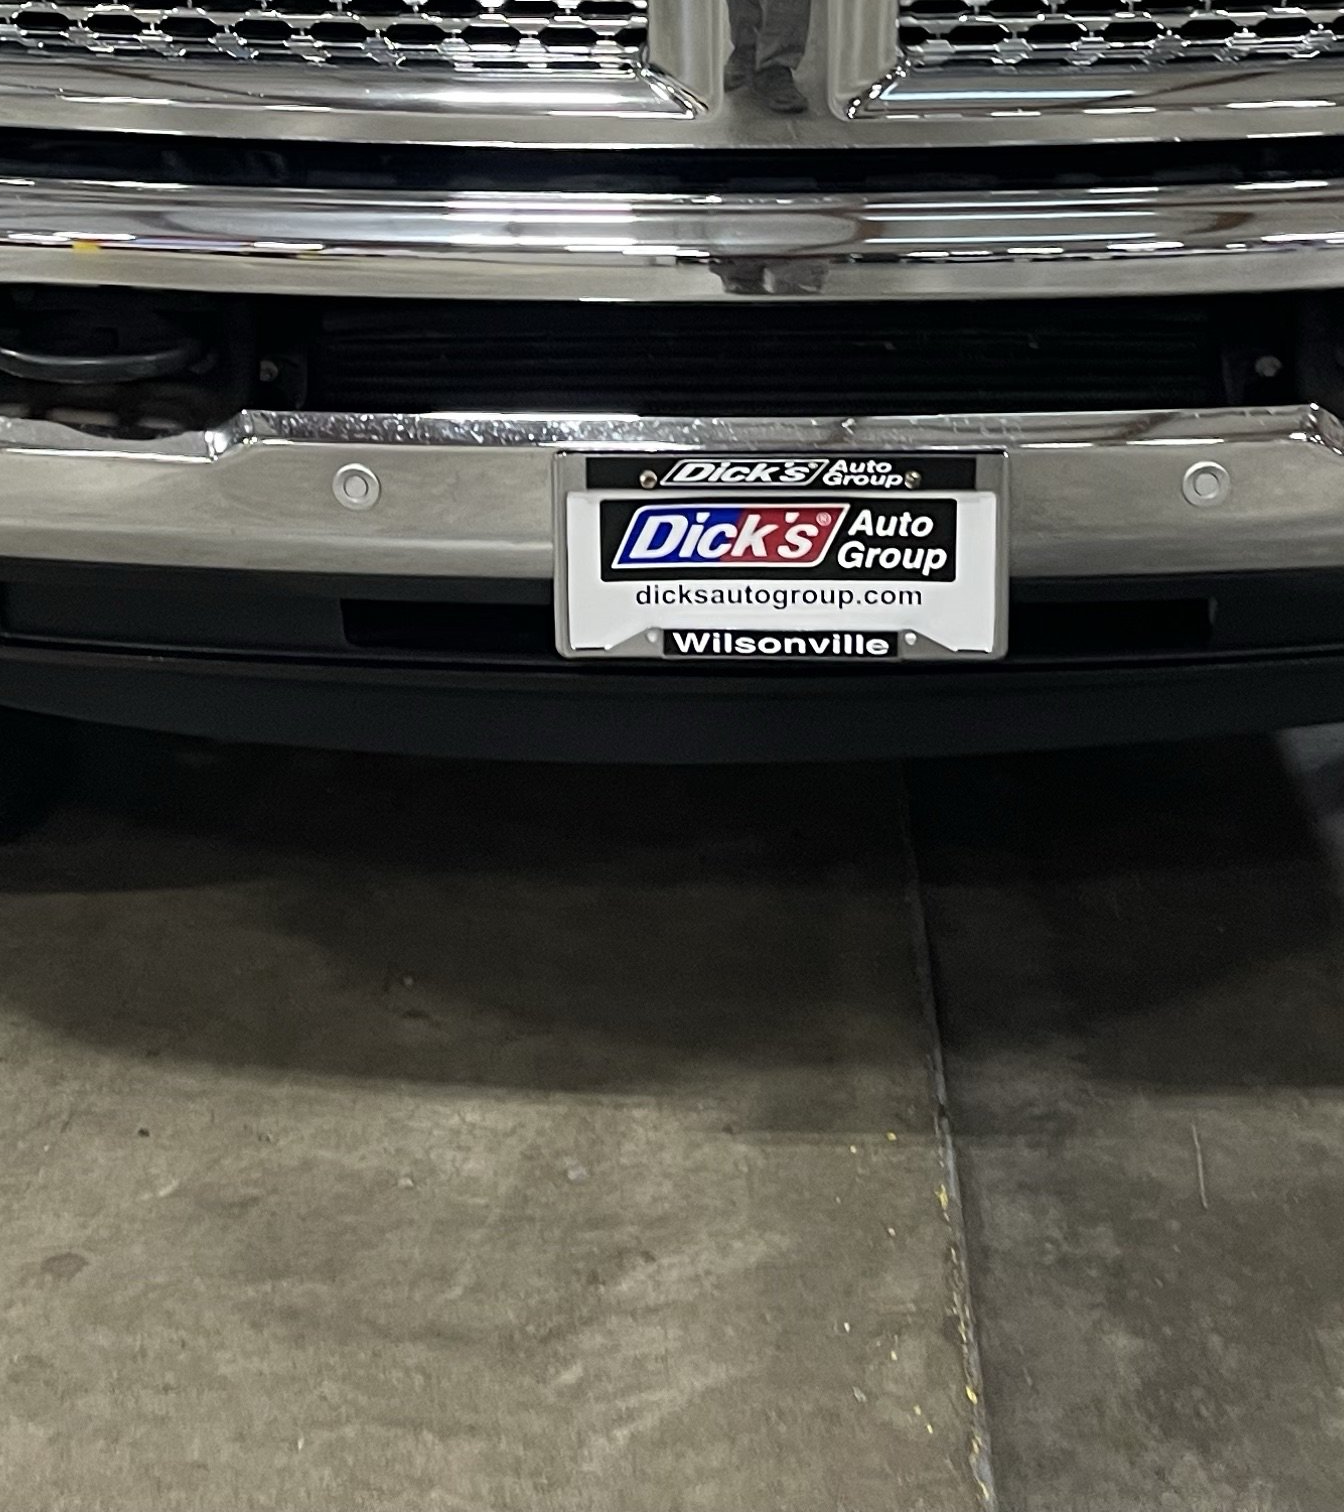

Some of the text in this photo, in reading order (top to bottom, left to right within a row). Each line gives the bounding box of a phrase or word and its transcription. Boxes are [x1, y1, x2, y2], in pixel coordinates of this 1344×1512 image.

[672, 460, 811, 482] Dick's
[829, 459, 892, 474] Auto
[822, 472, 904, 488] Group
[847, 509, 934, 537] Auto
[628, 512, 820, 559] Dick's
[837, 540, 948, 576] Group
[635, 584, 923, 609] dicksautogroup.com
[673, 632, 890, 655] Wilsonville
